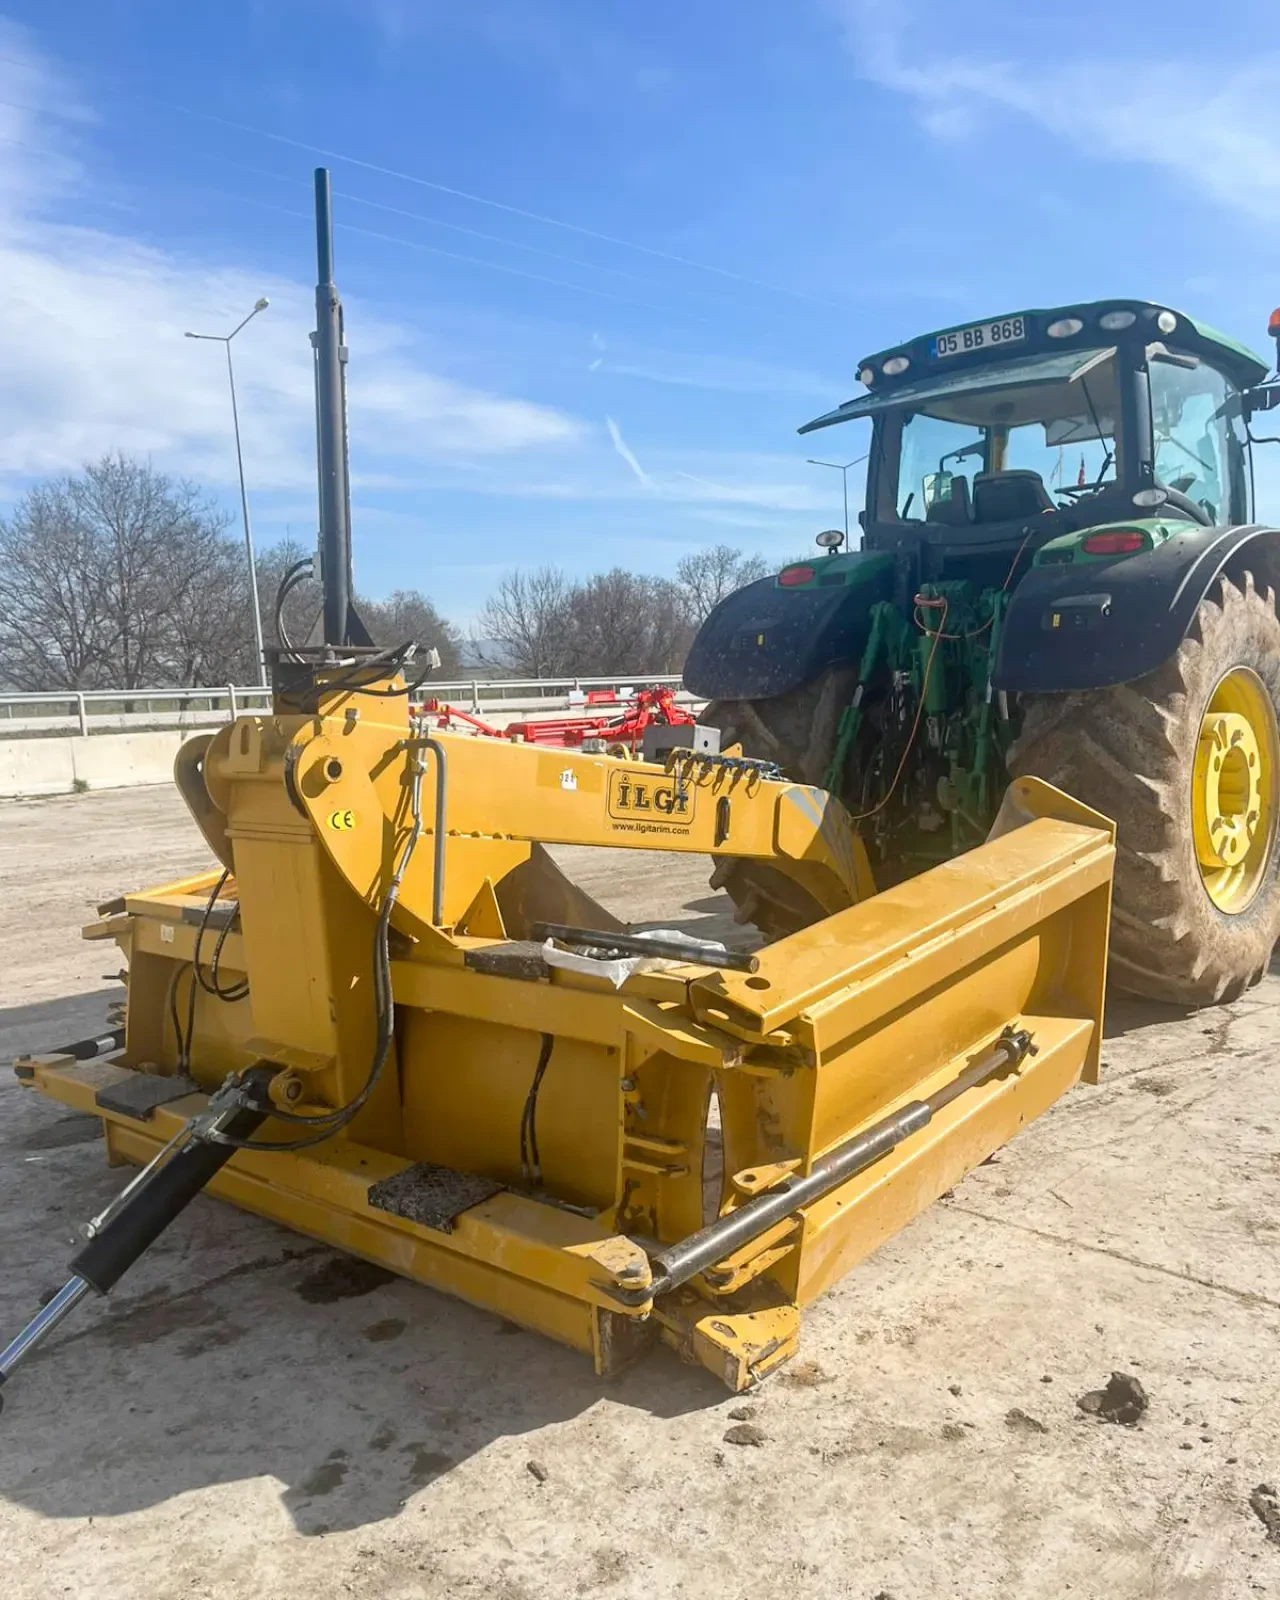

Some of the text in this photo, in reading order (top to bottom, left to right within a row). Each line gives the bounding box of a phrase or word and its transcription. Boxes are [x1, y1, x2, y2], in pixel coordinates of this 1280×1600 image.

[937, 319, 1023, 354] 05 BB 868
[332, 810, 352, 829] CE
[612, 823, 690, 835] www.ilgitarim.com
